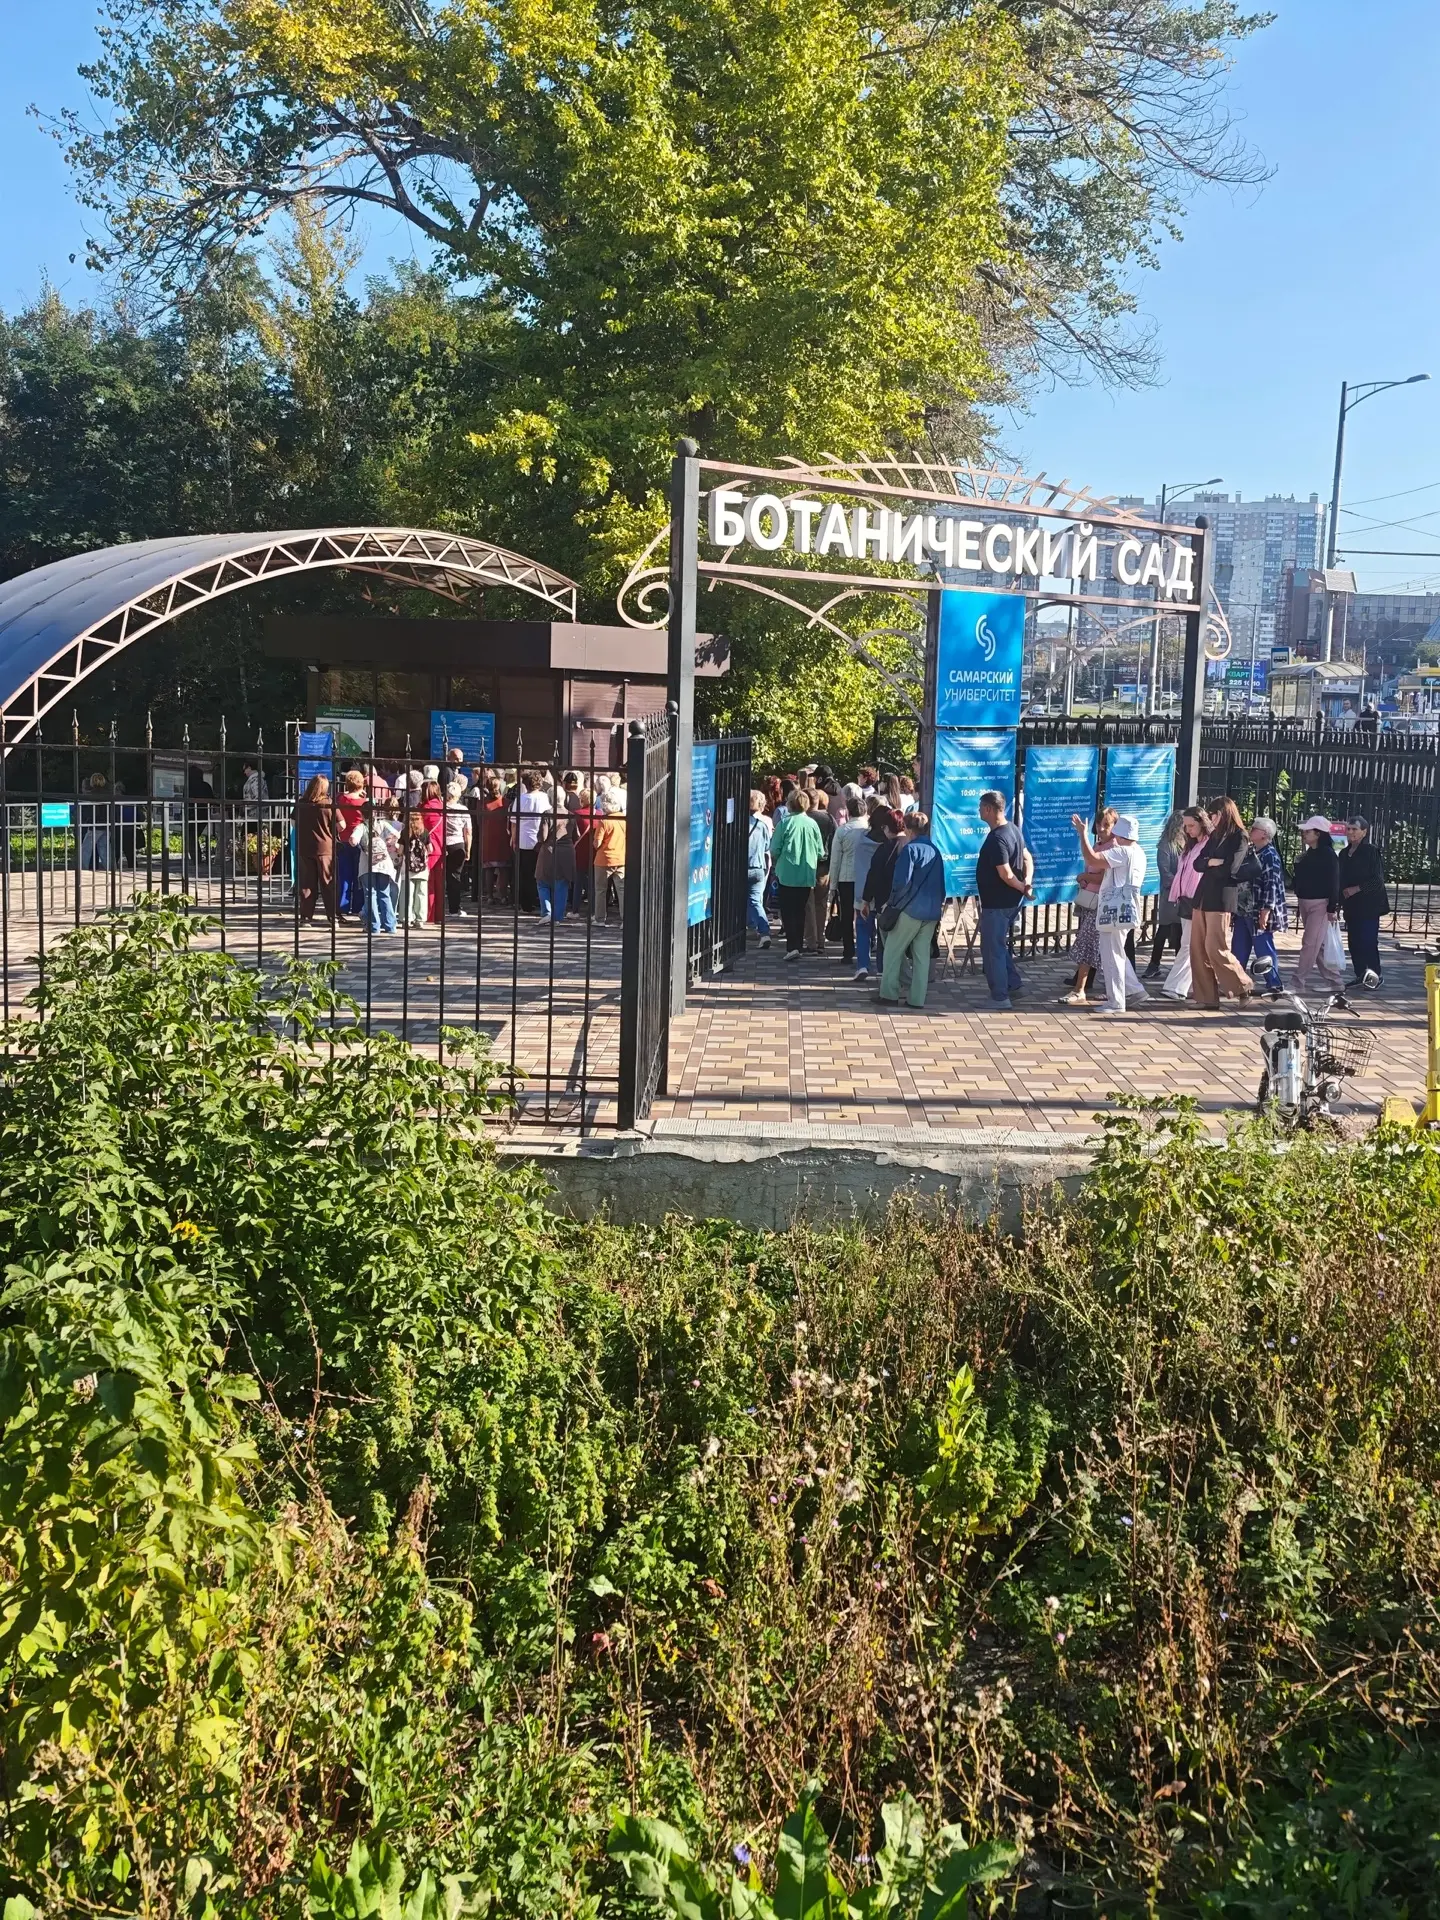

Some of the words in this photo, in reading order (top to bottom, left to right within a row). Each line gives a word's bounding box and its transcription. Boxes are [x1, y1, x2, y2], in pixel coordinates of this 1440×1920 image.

[711, 489, 1099, 582] БОТАНИЧЕСКИЙ
[1113, 538, 1197, 601] САД
[949, 667, 1013, 684] САМАРСКИЙ
[944, 687, 1016, 702] УНИВЕРСИТЕТ
[961, 789, 976, 797] 10:00
[960, 827, 974, 835] 10:00
[977, 826, 991, 834] 17:00
